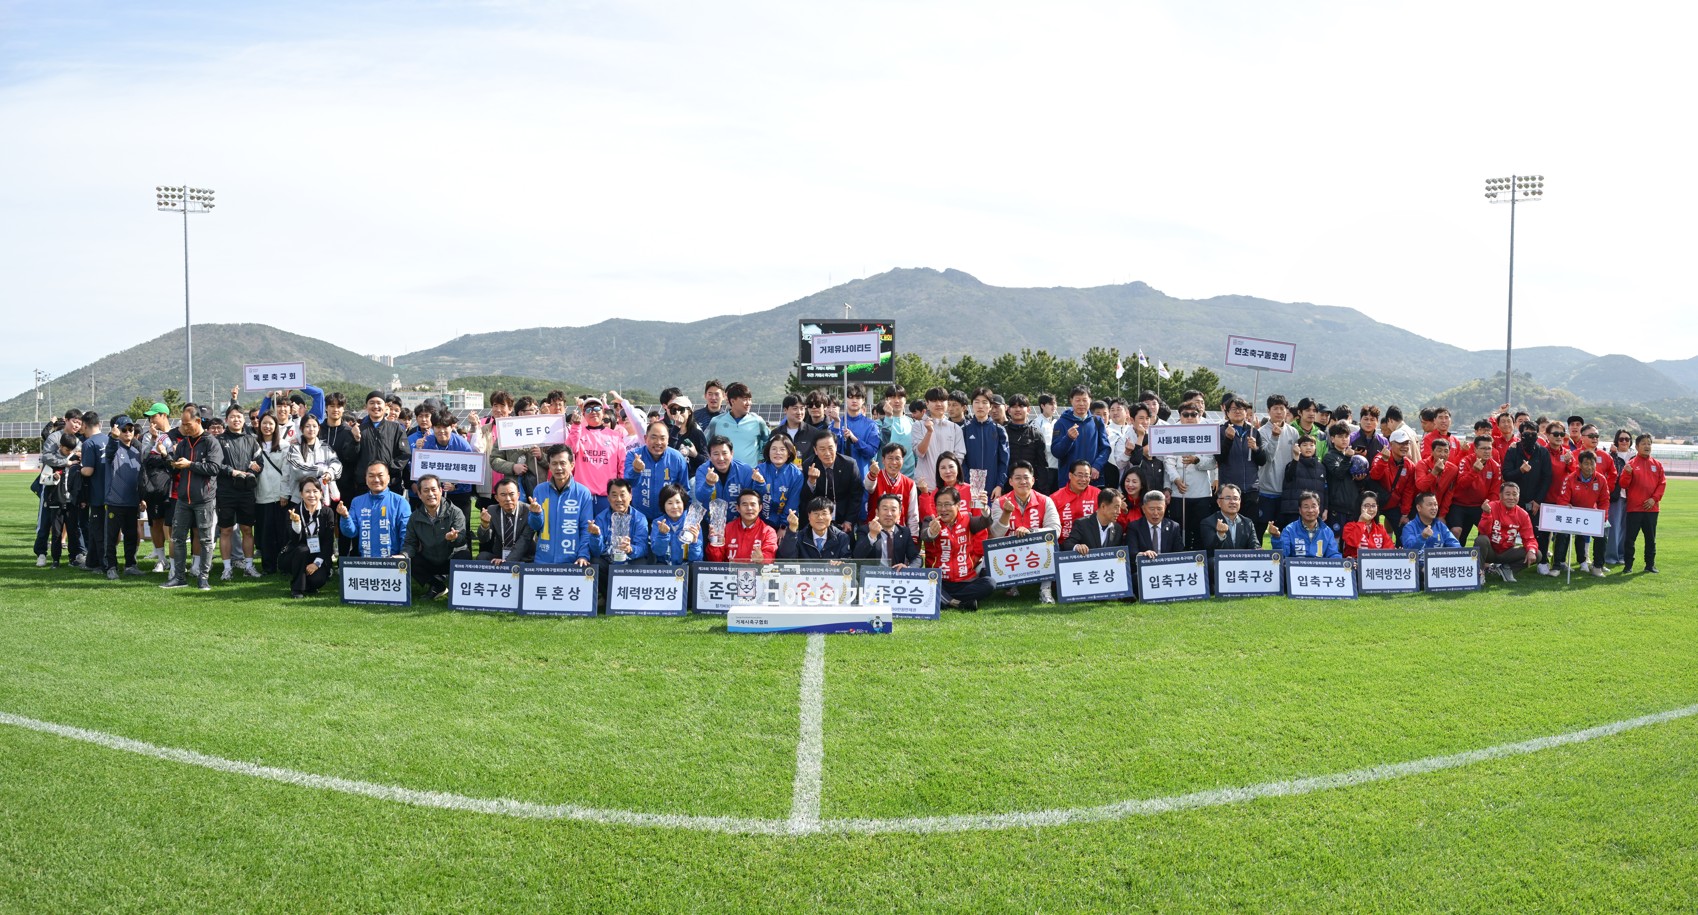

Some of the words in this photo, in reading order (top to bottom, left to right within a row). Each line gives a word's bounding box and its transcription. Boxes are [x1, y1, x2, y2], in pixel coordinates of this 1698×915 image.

[820, 344, 872, 354] 거제유나이티드
[1234, 347, 1287, 362] 연초축구동호회
[381, 506, 387, 516] 1
[541, 498, 550, 540] 1
[1004, 550, 1040, 571] 우승
[1072, 569, 1115, 586] 투혼상
[1225, 570, 1273, 584] 입축구상
[1366, 568, 1412, 580] 체력방전상
[1431, 566, 1474, 579] 체력방전상
[348, 577, 402, 592] 체력방전상
[1148, 572, 1198, 589] 입축구상
[1297, 576, 1346, 588] 입축구상
[460, 582, 512, 598] 입축구상
[535, 586, 581, 601] 투혼상
[616, 586, 678, 601] 체력방전상
[875, 585, 924, 604] 준우승
